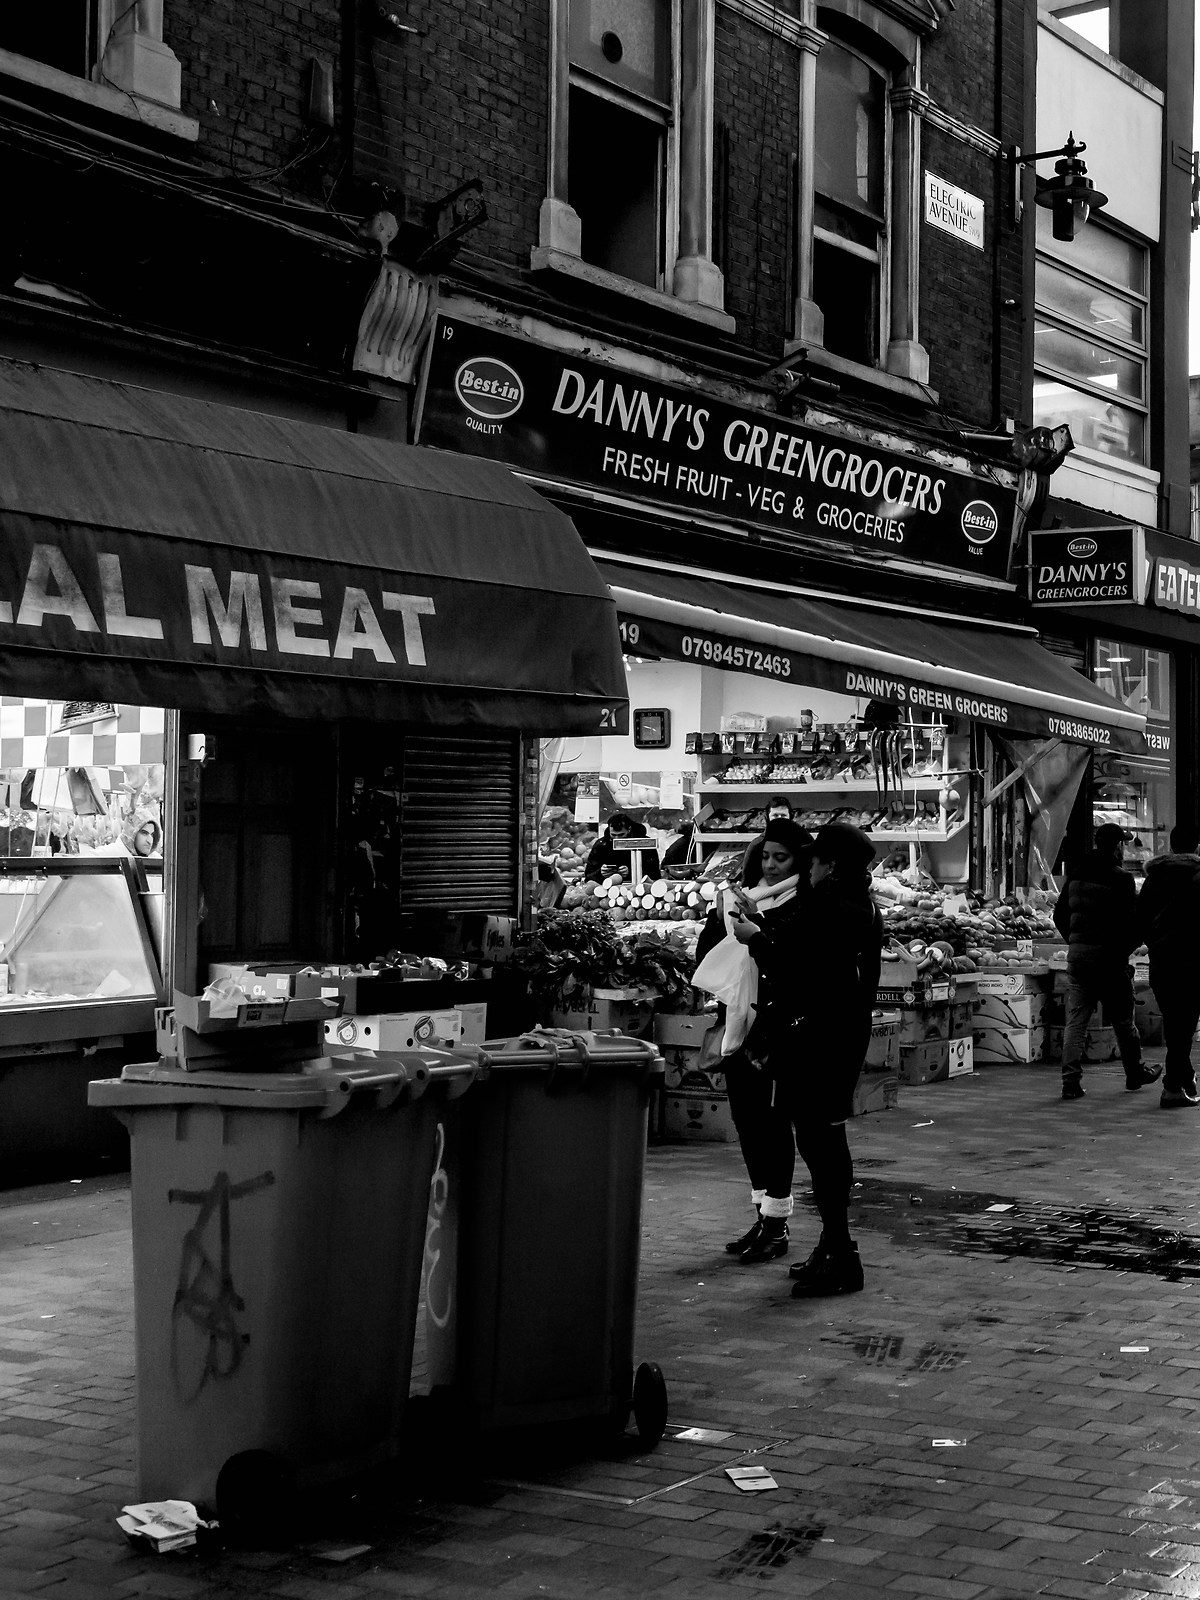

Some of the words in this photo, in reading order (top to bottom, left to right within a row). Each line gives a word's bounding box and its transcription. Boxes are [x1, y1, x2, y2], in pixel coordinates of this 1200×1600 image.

[930, 183, 976, 220] ELECTRIC
[929, 202, 968, 234] AVENUE
[442, 326, 454, 340] 19
[466, 416, 502, 434] QUALITY
[552, 368, 710, 450] DANNY'S
[724, 420, 946, 514] GREENGROCERS
[602, 446, 670, 486] FRESH
[676, 466, 733, 500] FRUIT
[748, 484, 785, 514] VEG
[792, 496, 804, 520] &
[816, 502, 905, 543] GROCERIES
[968, 544, 983, 556] VALUE
[1038, 562, 1127, 584] DANNY'S
[1037, 585, 1128, 600] GREENGROCERS
[184, 564, 436, 666] MEAT
[619, 622, 640, 644] 19
[682, 636, 791, 676] 07984572463
[846, 672, 906, 701] DANNY'S
[909, 687, 954, 711] GREEN
[956, 697, 1008, 723] GROCERS
[600, 708, 618, 728] 21
[1048, 717, 1110, 744] 07983865022
[876, 993, 900, 1001] RDELL
